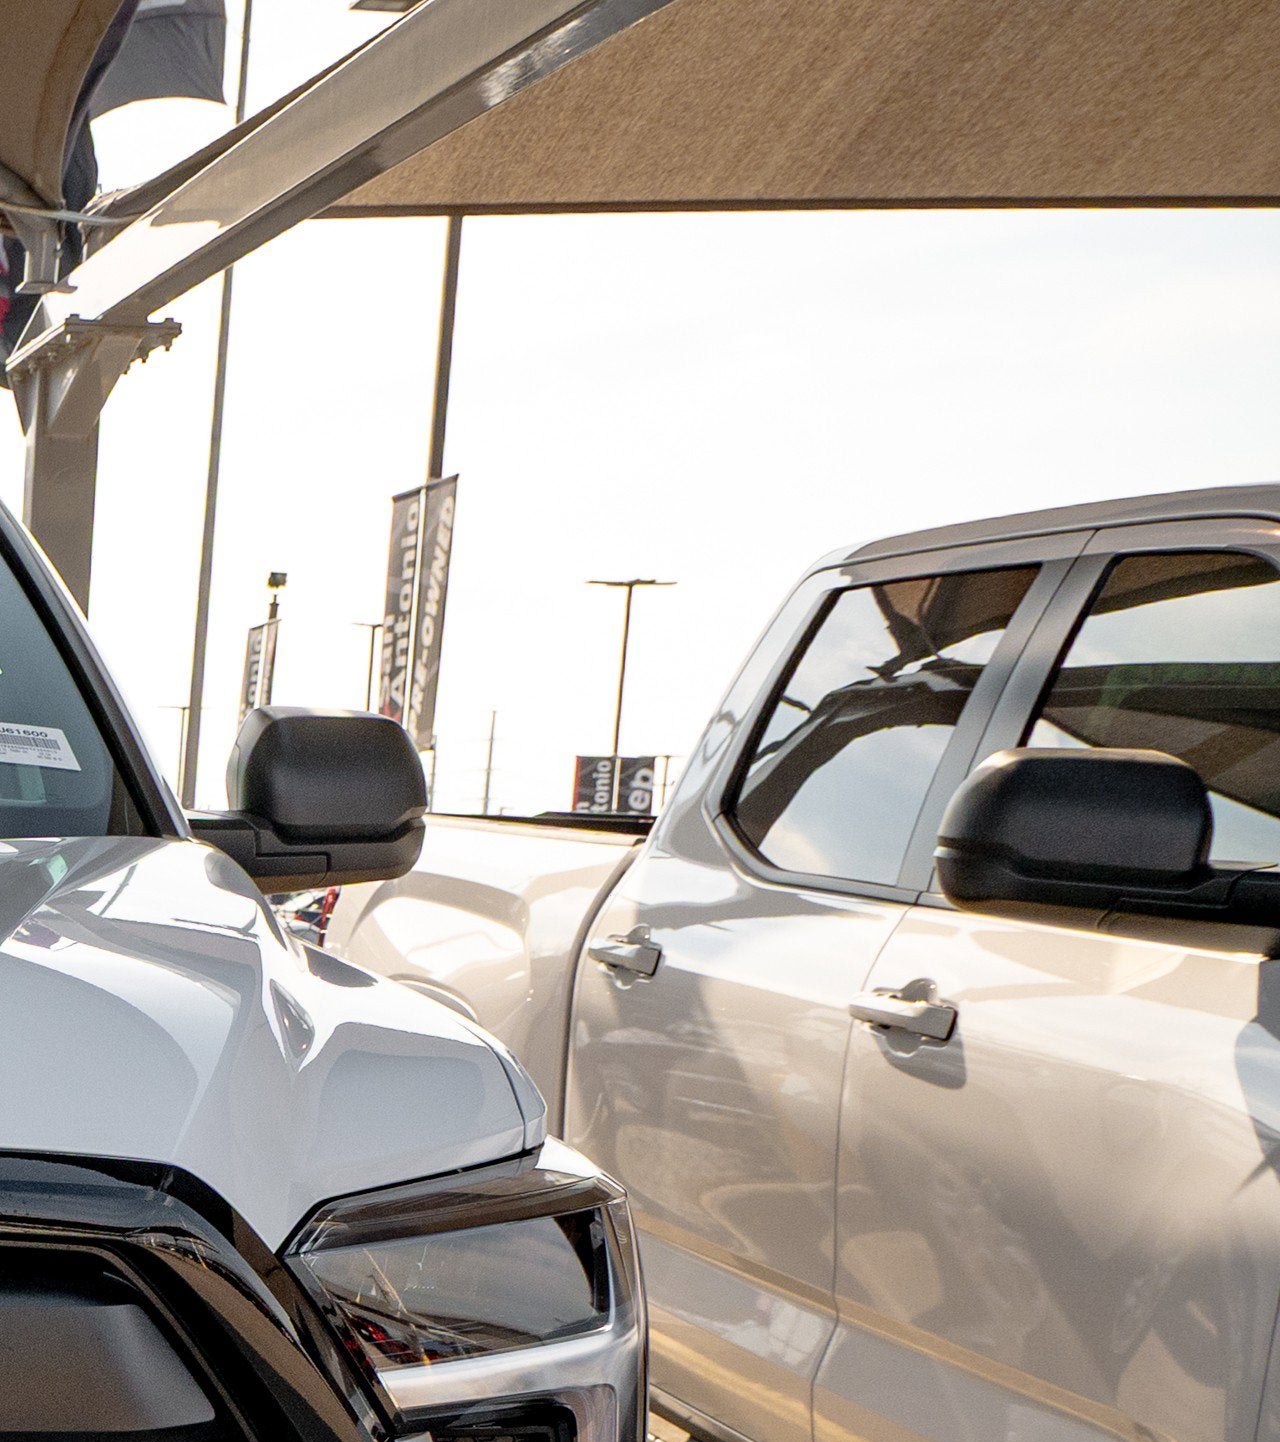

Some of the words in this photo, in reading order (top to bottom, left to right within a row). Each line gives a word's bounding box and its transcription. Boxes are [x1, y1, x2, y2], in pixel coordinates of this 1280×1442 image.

[390, 501, 419, 707] Antonio
[590, 760, 612, 813] tonio
[627, 767, 654, 815] ep
